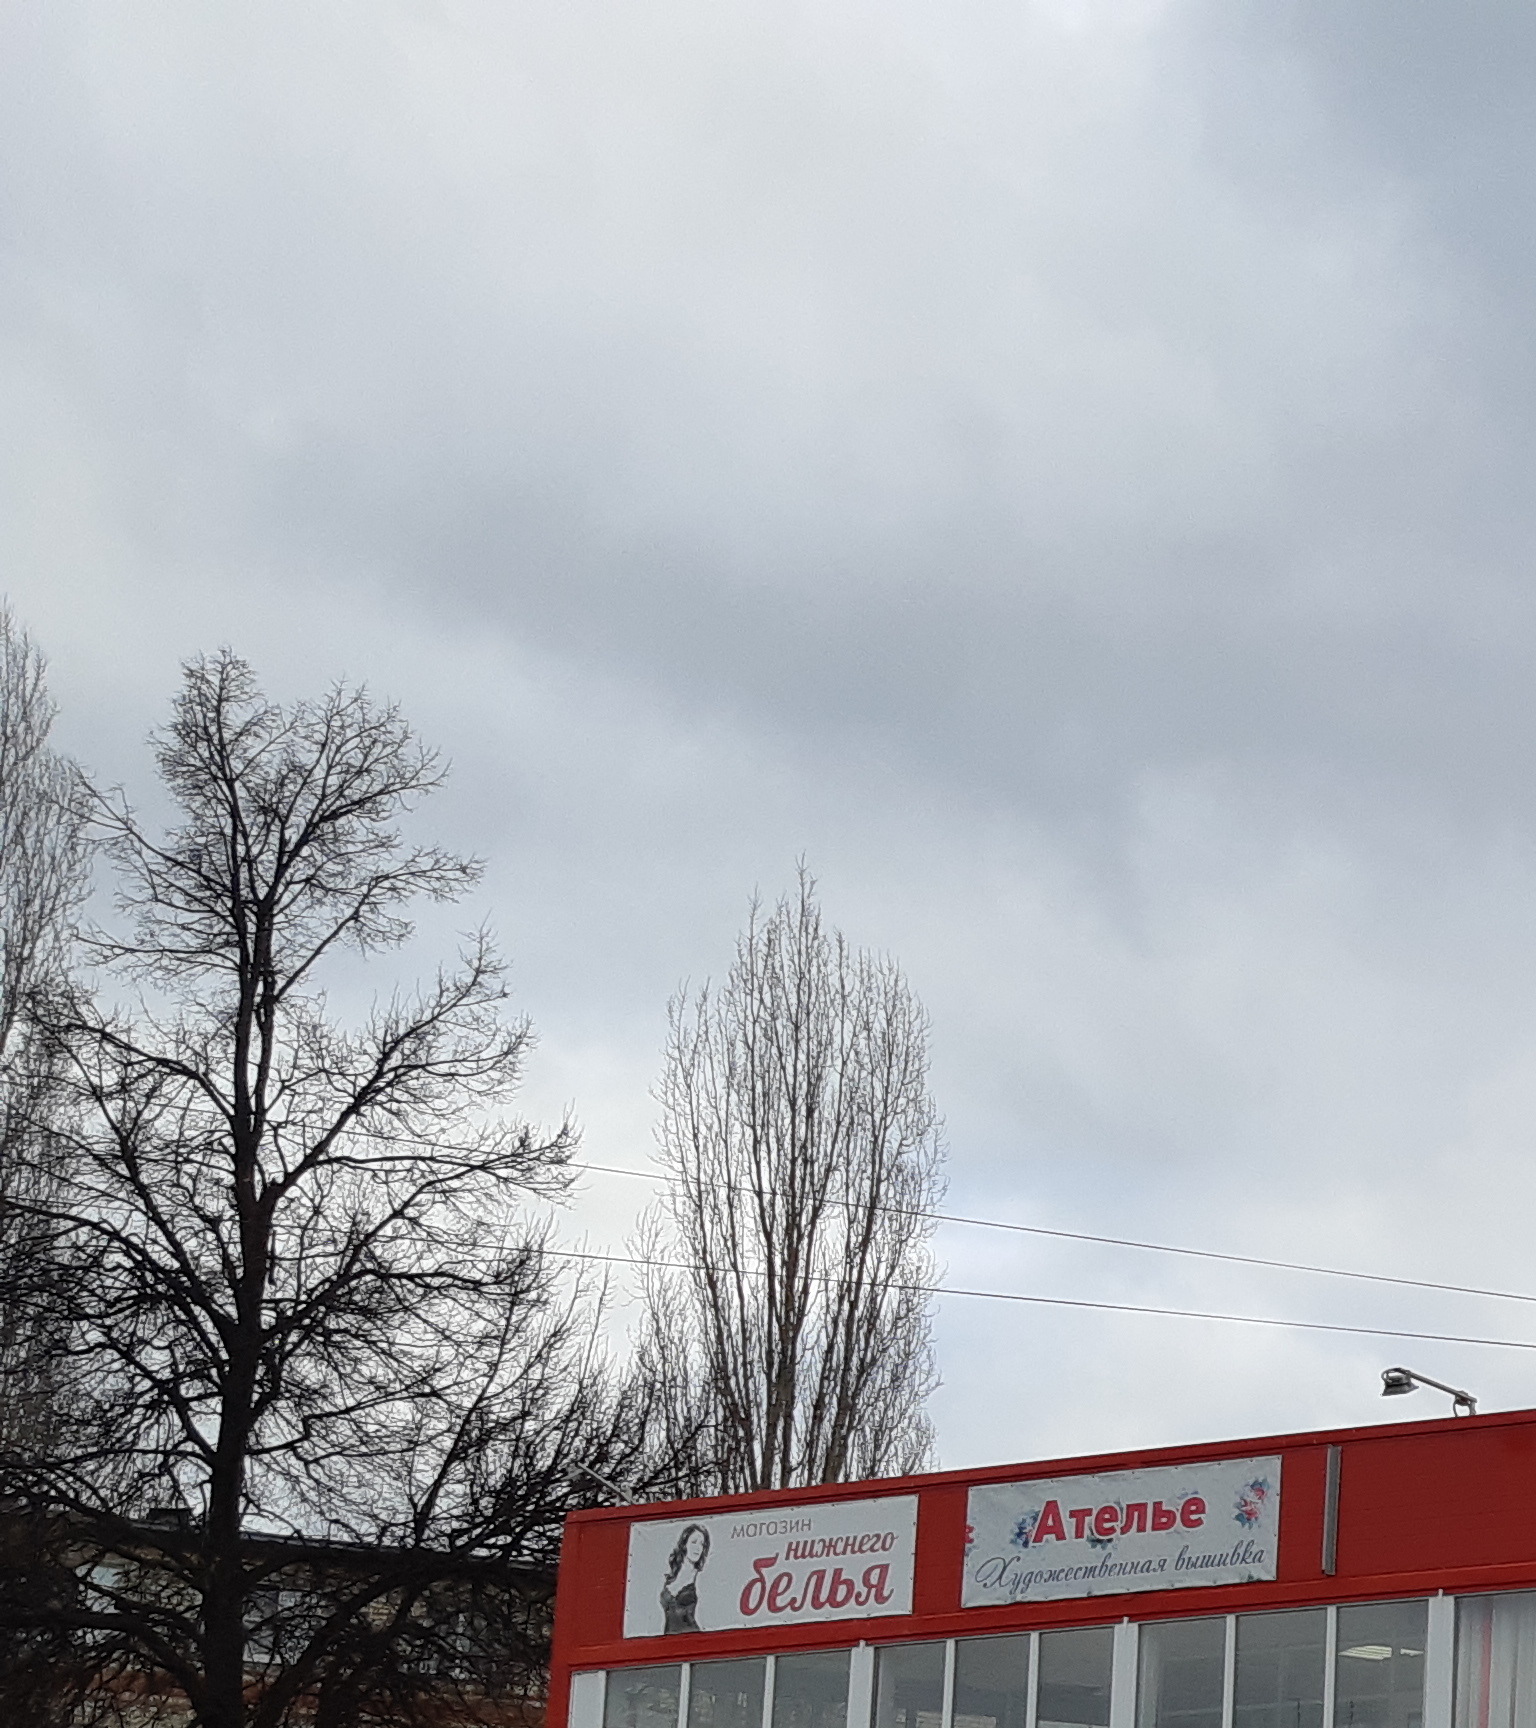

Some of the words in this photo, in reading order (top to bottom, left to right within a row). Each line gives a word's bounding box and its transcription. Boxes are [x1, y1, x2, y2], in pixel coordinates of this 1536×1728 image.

[731, 1518, 812, 1539] магазин
[1032, 1496, 1207, 1544] Ателье
[785, 1531, 900, 1561] нижнего
[975, 1552, 1167, 1595] Художественная
[1174, 1540, 1265, 1572] вышивка
[739, 1552, 895, 1616] белья
